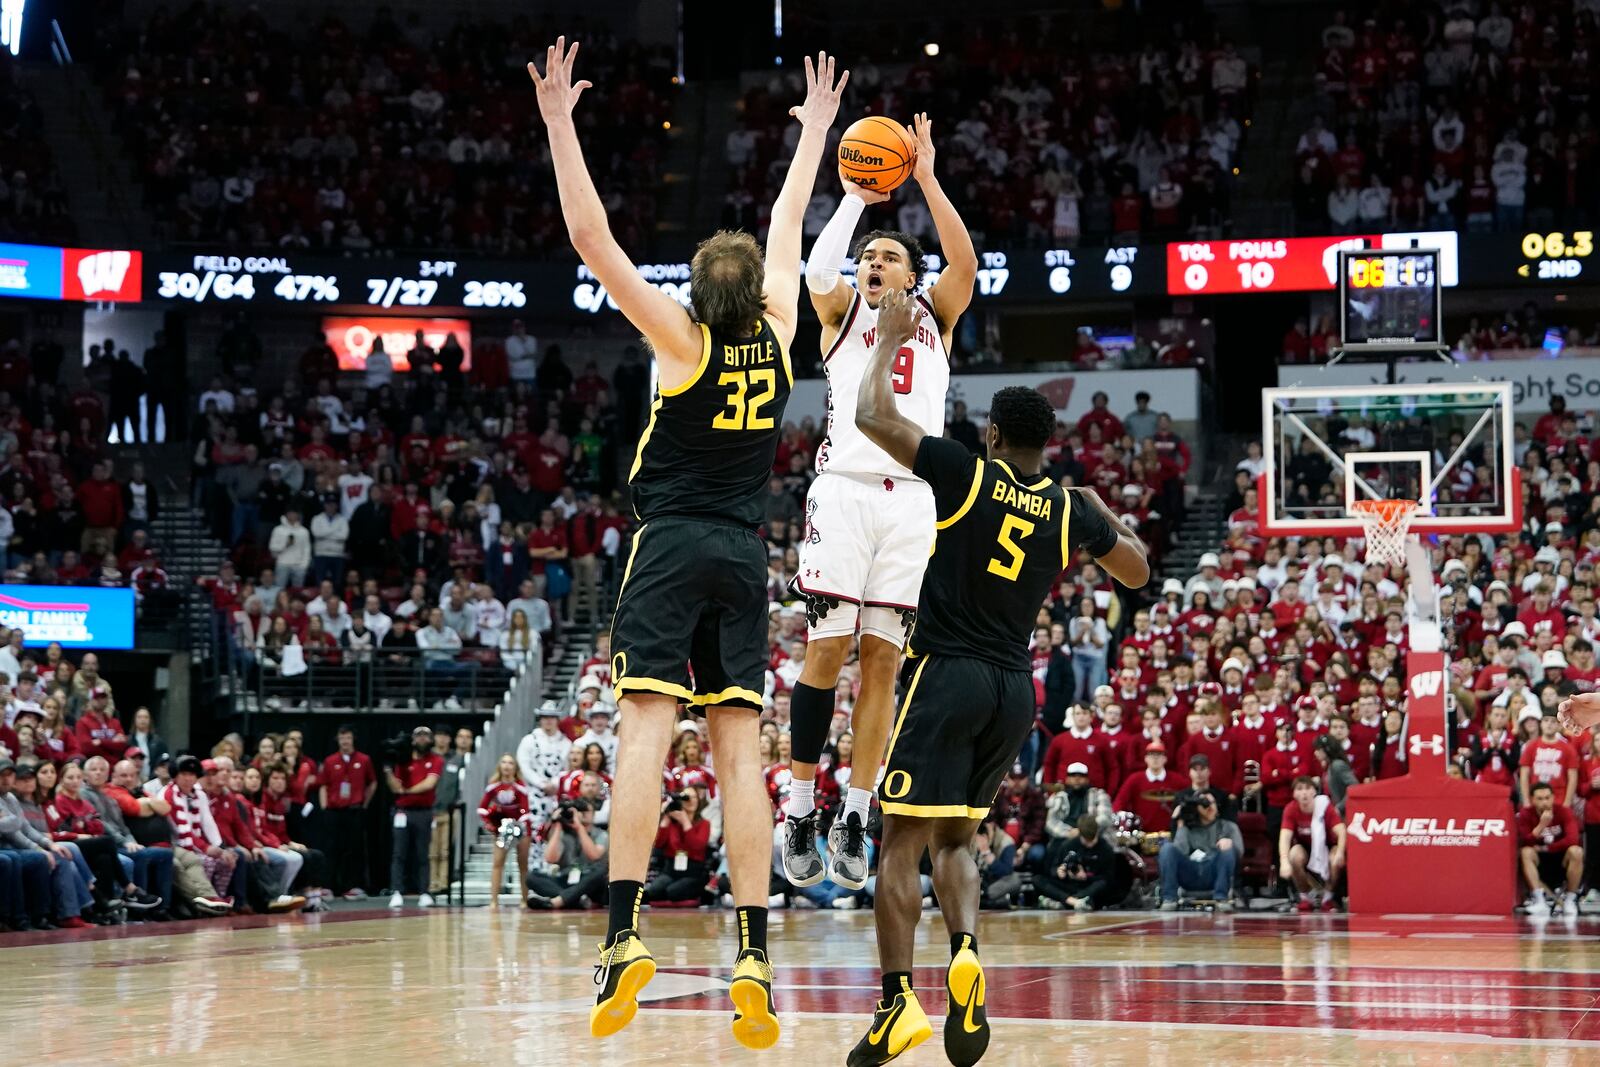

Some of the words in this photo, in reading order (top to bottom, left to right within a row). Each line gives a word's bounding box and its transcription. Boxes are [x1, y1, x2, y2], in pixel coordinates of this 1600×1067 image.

[840, 146, 883, 166] Wilson
[1105, 247, 1137, 264] AST
[1178, 244, 1215, 262] TOL
[1229, 240, 1288, 260] FOULS
[1522, 231, 1593, 258] 06.3
[194, 255, 242, 272] FIELD
[244, 257, 292, 273] GOAL
[419, 260, 457, 277] 3-PT
[982, 252, 1007, 268] TO
[1045, 250, 1075, 267] STL
[1538, 259, 1582, 278] 2ND
[158, 271, 255, 302] 30/64
[274, 275, 340, 301] 47%
[977, 267, 1009, 295] 17
[1049, 266, 1071, 294] 6
[1110, 264, 1133, 291] 9
[1184, 264, 1208, 291] 0
[1237, 261, 1275, 289] 10
[366, 277, 439, 308] 7/27
[463, 281, 527, 308] 26%
[724, 341, 774, 367] BITTLE
[712, 369, 775, 430] 32
[991, 479, 1052, 521] BAMBA
[986, 513, 1036, 582] 5
[32, 611, 87, 625] FAMILY
[1367, 818, 1507, 836] MUELLER
[1390, 835, 1431, 846] SPORTS
[1431, 836, 1481, 847] MEDICINE
